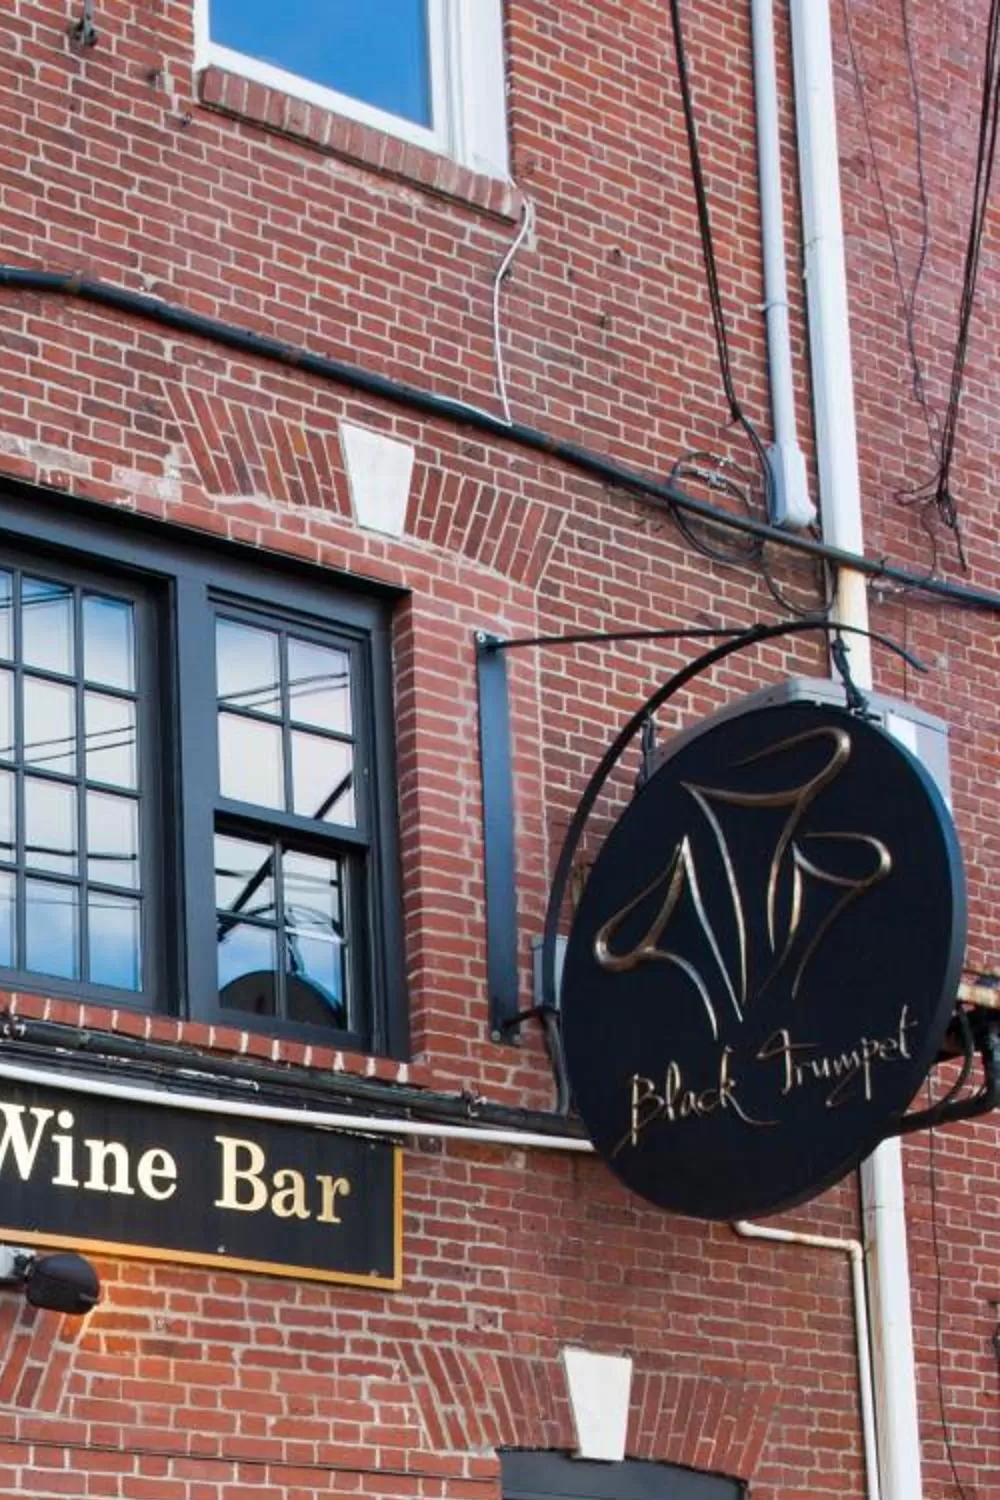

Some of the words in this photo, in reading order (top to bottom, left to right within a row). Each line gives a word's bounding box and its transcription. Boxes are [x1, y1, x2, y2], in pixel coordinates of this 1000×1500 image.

[612, 1045, 781, 1159] Black
[756, 1004, 919, 1107] Trumpet
[214, 1135, 350, 1223] Bar
